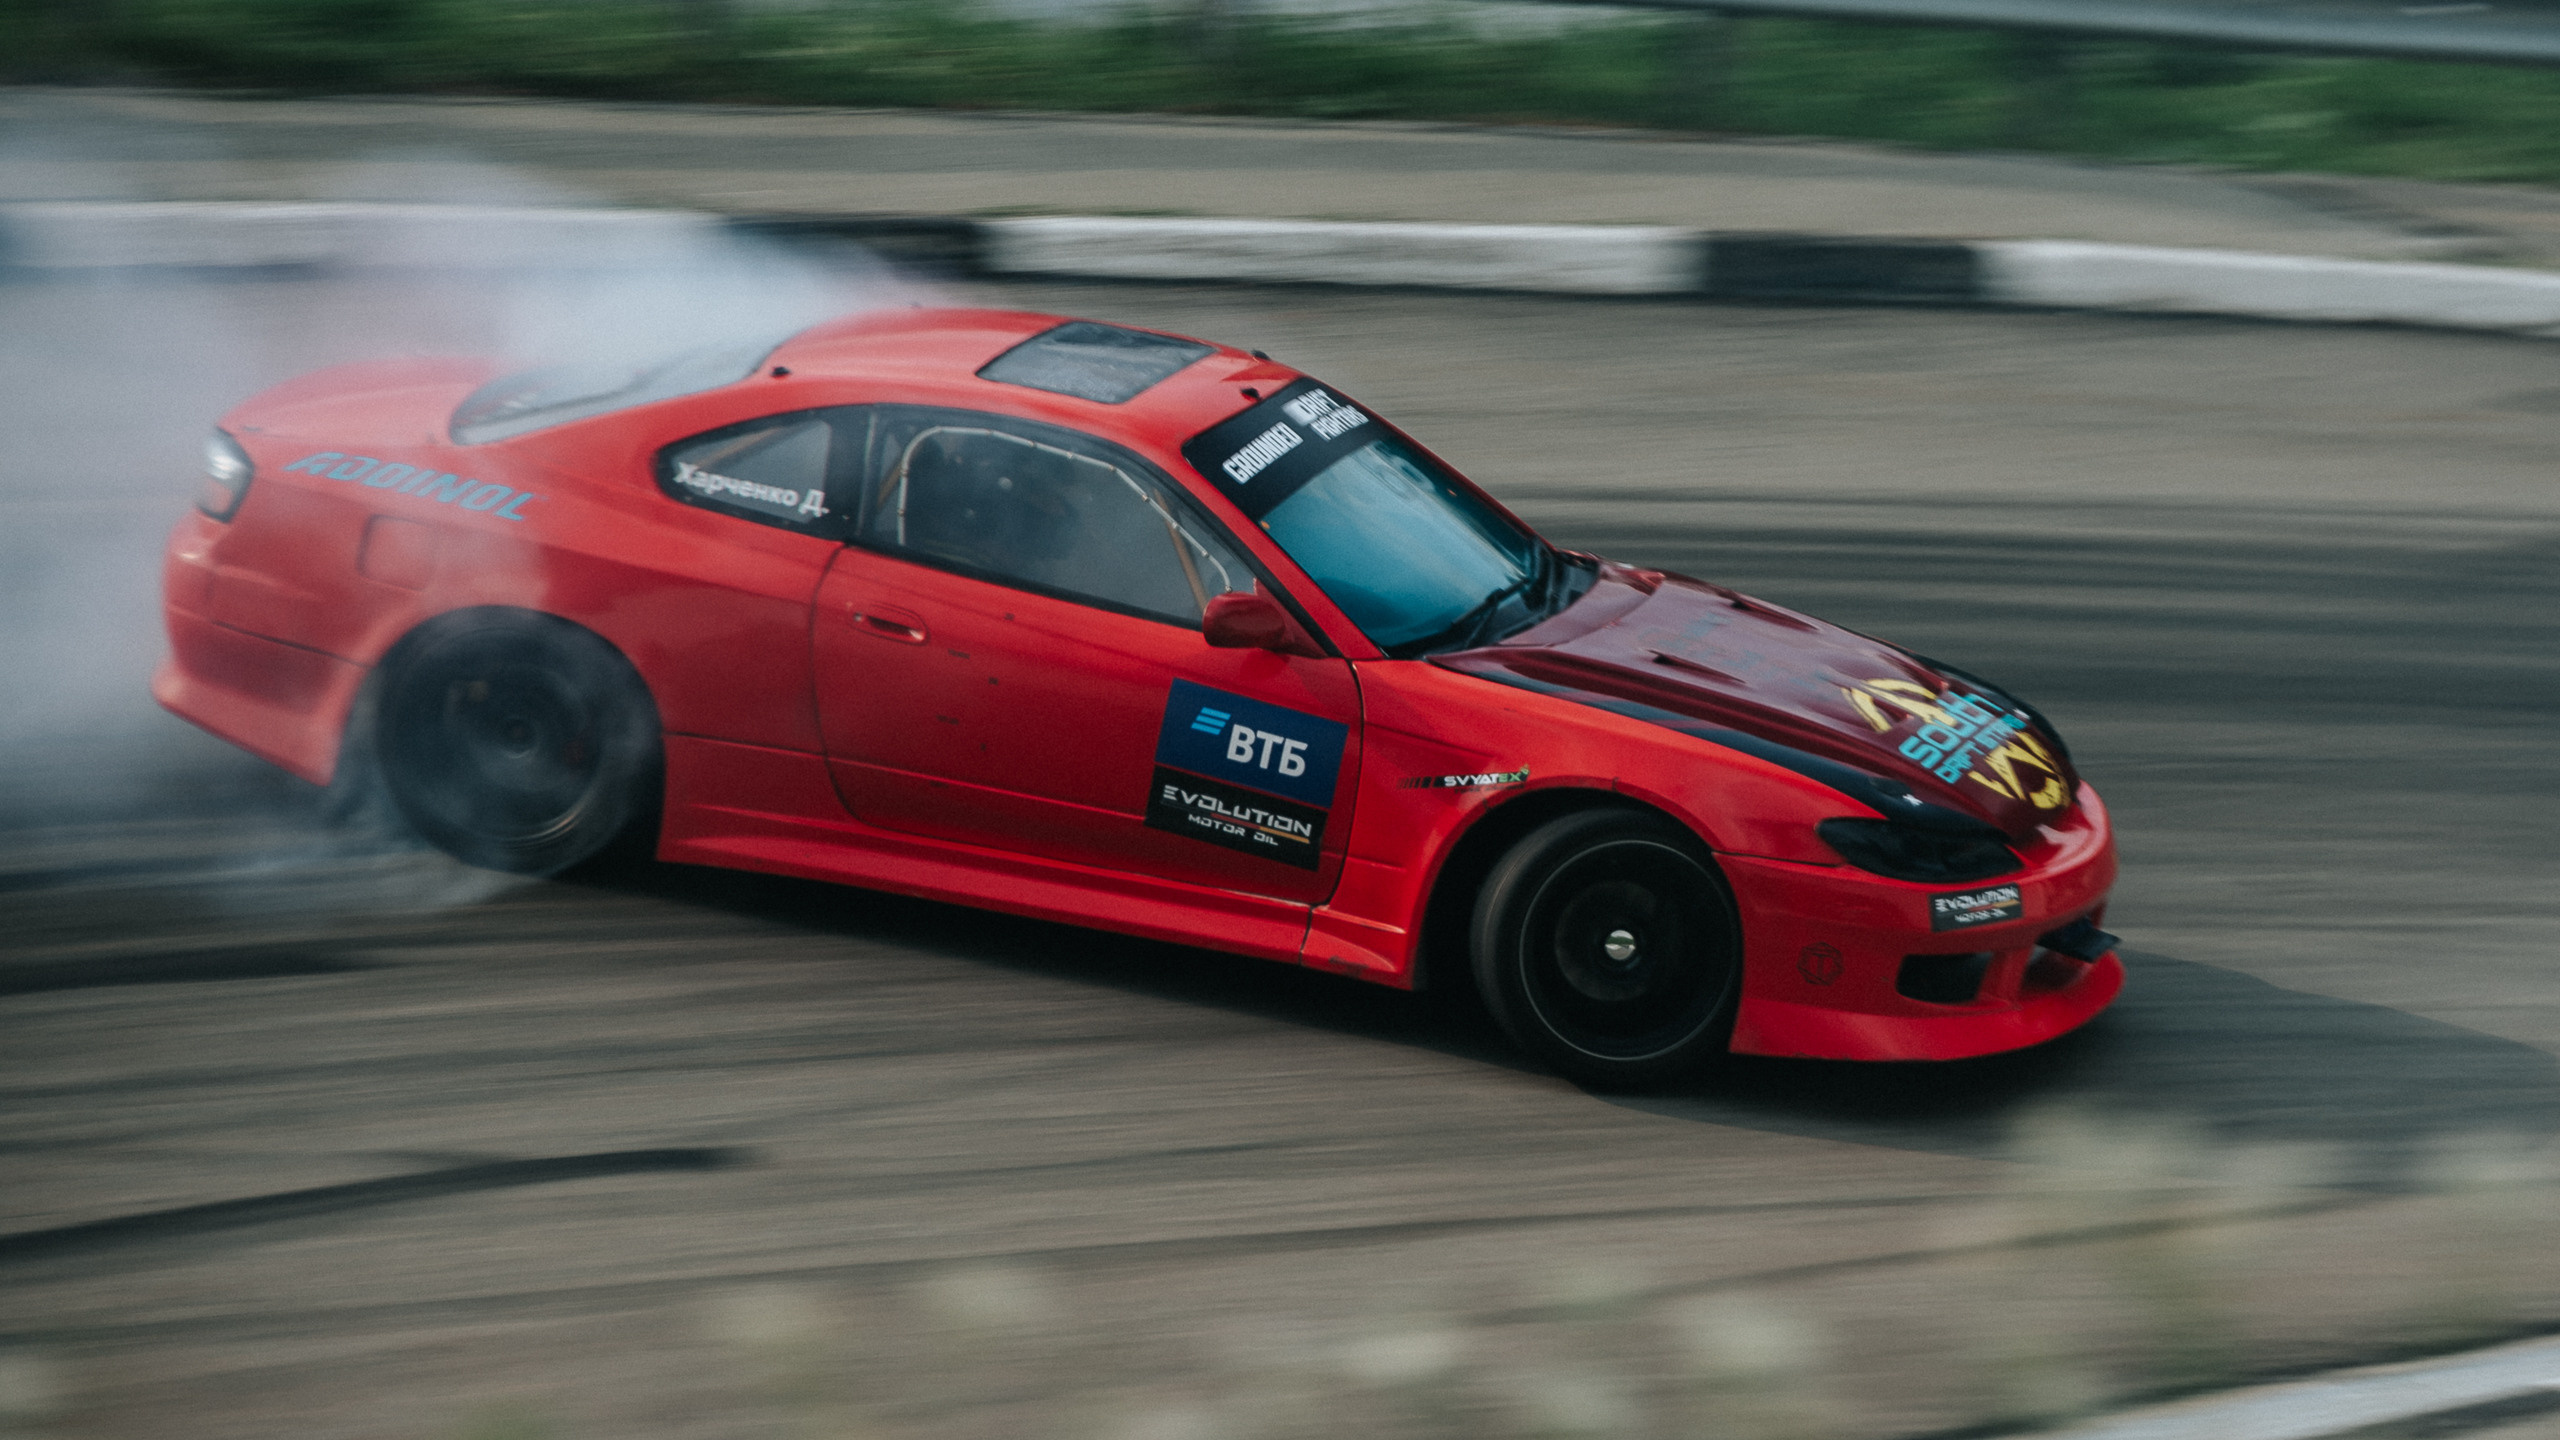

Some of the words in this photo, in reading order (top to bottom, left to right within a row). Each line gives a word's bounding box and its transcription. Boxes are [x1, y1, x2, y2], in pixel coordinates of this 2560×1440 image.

[1284, 388, 1341, 426] DRIFT
[1222, 421, 1304, 484] GROUNDED
[283, 451, 535, 521] ADDINOL
[673, 462, 799, 507] Харченко
[1226, 723, 1308, 777] ВТБ
[1444, 773, 1521, 787] SVYATEX
[1162, 784, 1312, 837] EVOLUTION
[1188, 814, 1246, 837] MOTOR
[1253, 832, 1279, 846] OIL
